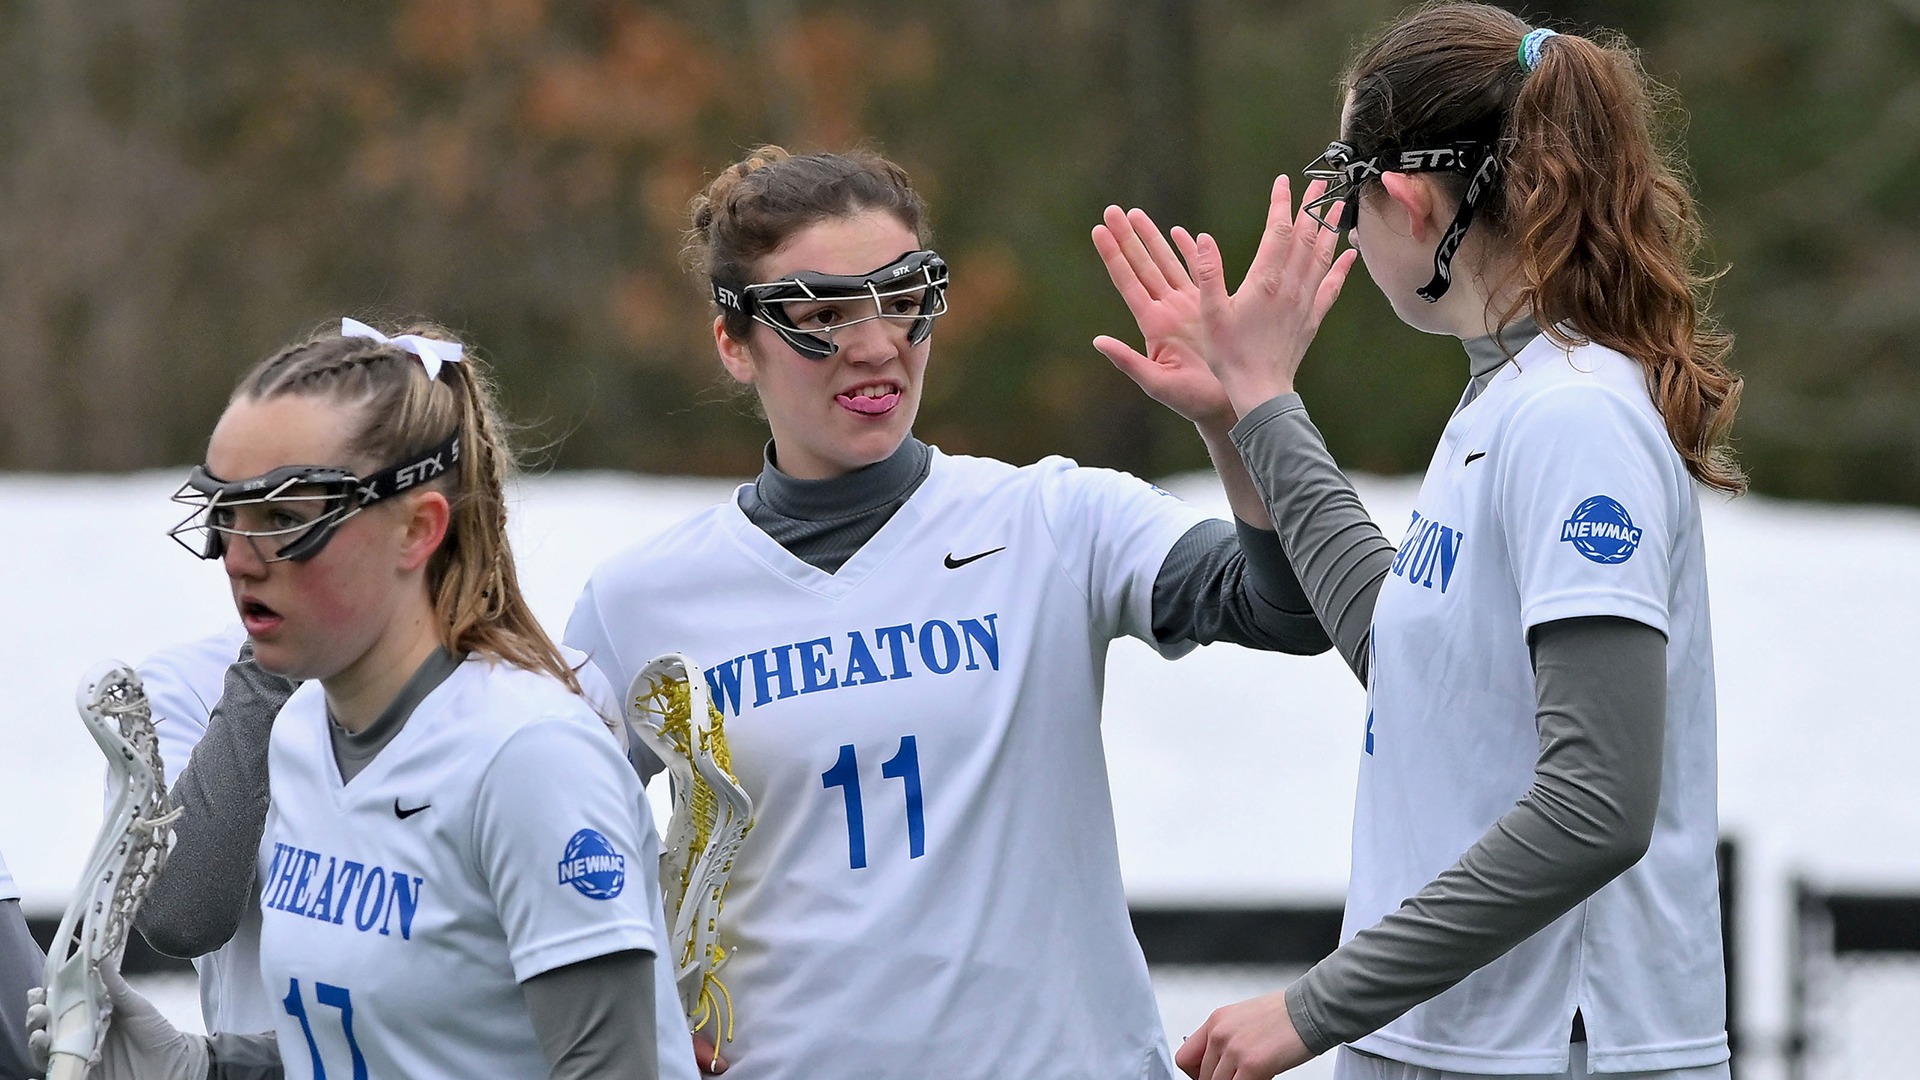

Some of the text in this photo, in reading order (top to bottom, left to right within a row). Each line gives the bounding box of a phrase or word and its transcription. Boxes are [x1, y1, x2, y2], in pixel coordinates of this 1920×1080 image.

[1345, 156, 1380, 182] TX
[1400, 148, 1466, 171] STX
[1437, 223, 1466, 283] STX
[892, 264, 909, 278] STX
[718, 286, 740, 310] STX
[396, 452, 444, 490] STX
[1563, 521, 1640, 546] NEWMAC
[704, 613, 1001, 717] WHEATON
[821, 735, 926, 869] 11
[560, 854, 624, 882] NEWMAC
[282, 977, 369, 1080] 17
